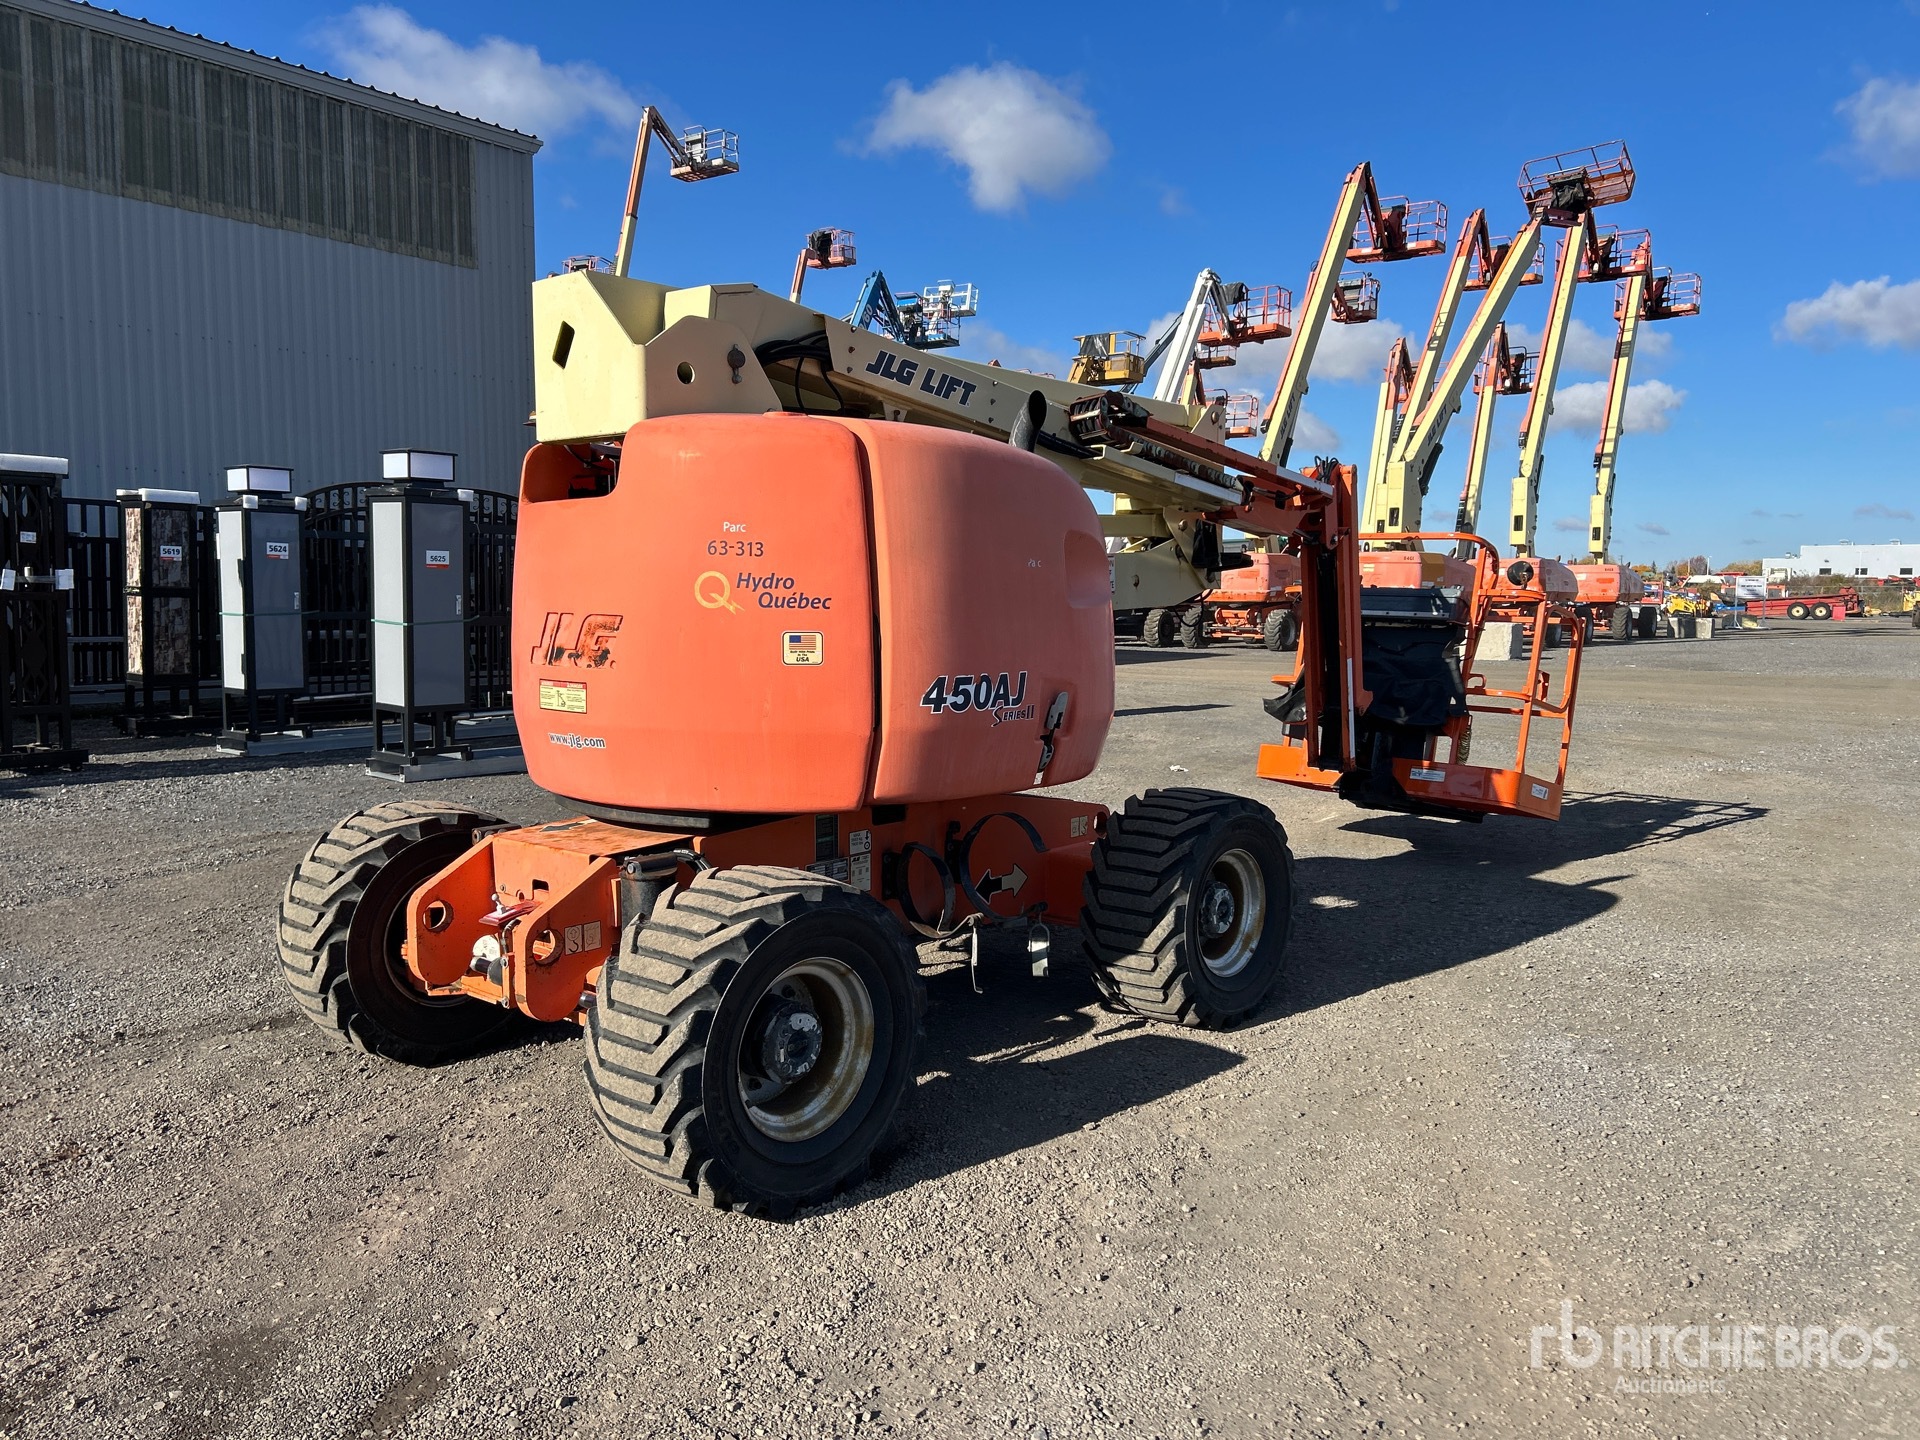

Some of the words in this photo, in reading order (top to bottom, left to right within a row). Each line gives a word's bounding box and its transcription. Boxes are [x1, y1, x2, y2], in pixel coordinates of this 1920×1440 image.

[865, 350, 920, 387] JLG
[919, 367, 977, 406] LIFT
[723, 521, 746, 533] Parc
[162, 547, 181, 556] 5619
[268, 545, 288, 553] 5624
[707, 540, 764, 557] 63-313
[429, 555, 446, 563] 5625
[736, 572, 795, 592] Hydro
[758, 592, 832, 610] Québec
[920, 670, 1028, 714] 450AJ
[548, 732, 606, 749] www.jlg.com
